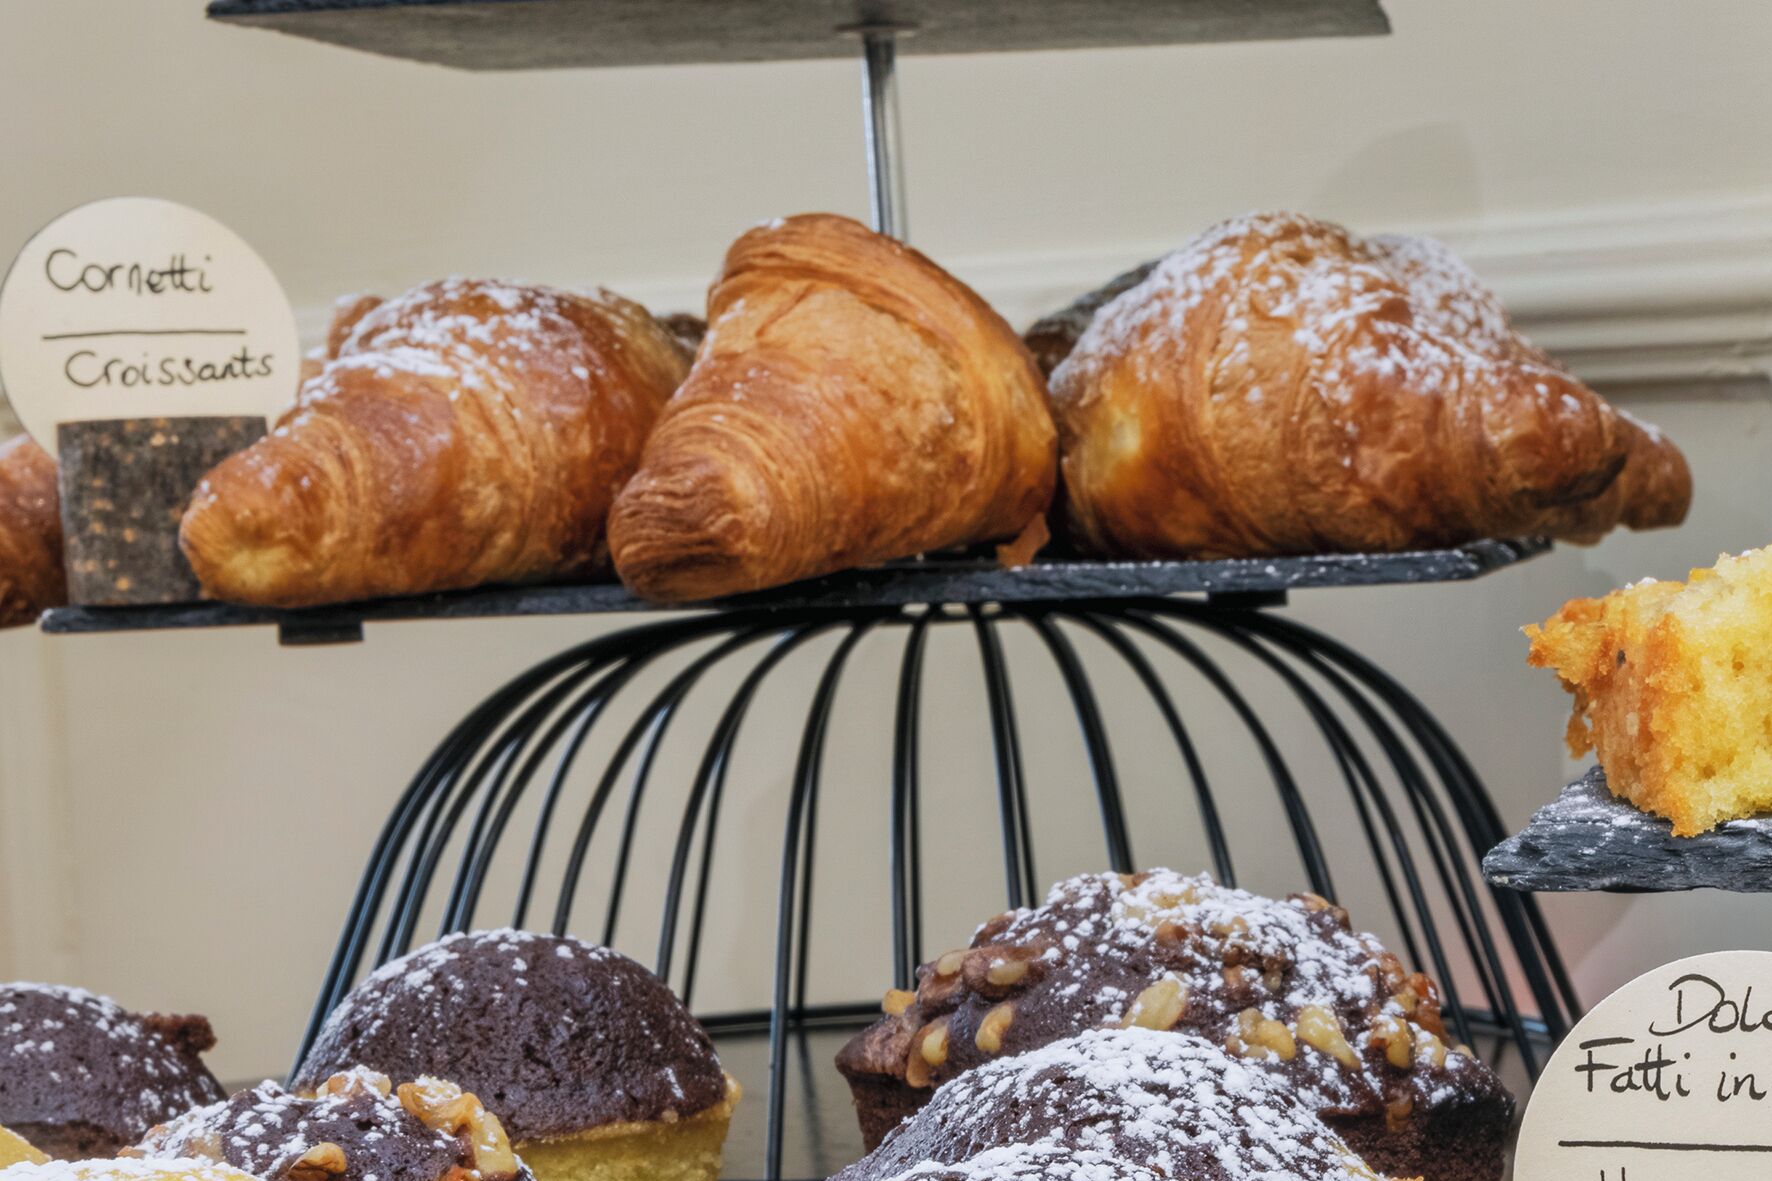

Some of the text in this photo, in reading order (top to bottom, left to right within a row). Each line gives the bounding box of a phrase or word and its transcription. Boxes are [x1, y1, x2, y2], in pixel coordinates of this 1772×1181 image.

[46, 248, 213, 295] Cornetti
[64, 346, 274, 387] Croissants
[1574, 1037, 1691, 1100] Fatti
[1716, 1052, 1767, 1101] in
